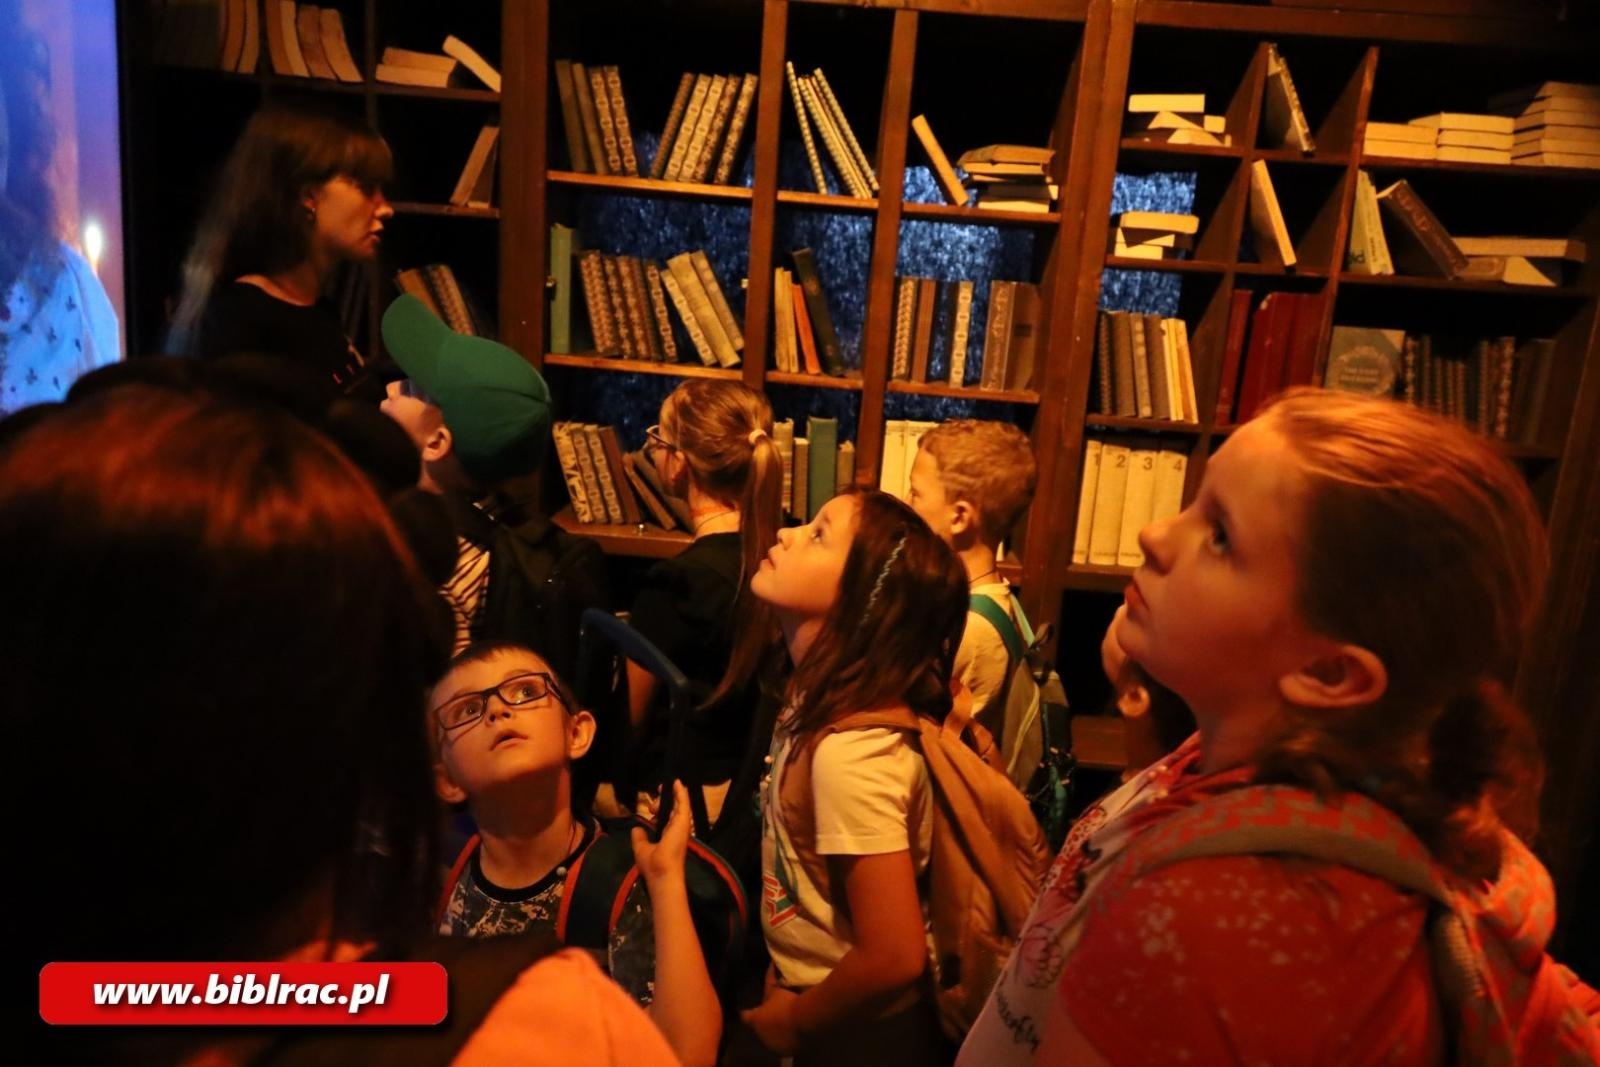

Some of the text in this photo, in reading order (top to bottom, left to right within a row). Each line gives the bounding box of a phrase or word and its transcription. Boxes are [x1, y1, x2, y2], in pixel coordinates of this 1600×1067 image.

[1094, 453, 1100, 466] 1
[1117, 455, 1126, 468] 2
[1143, 457, 1152, 470] 3
[1174, 460, 1182, 471] 4
